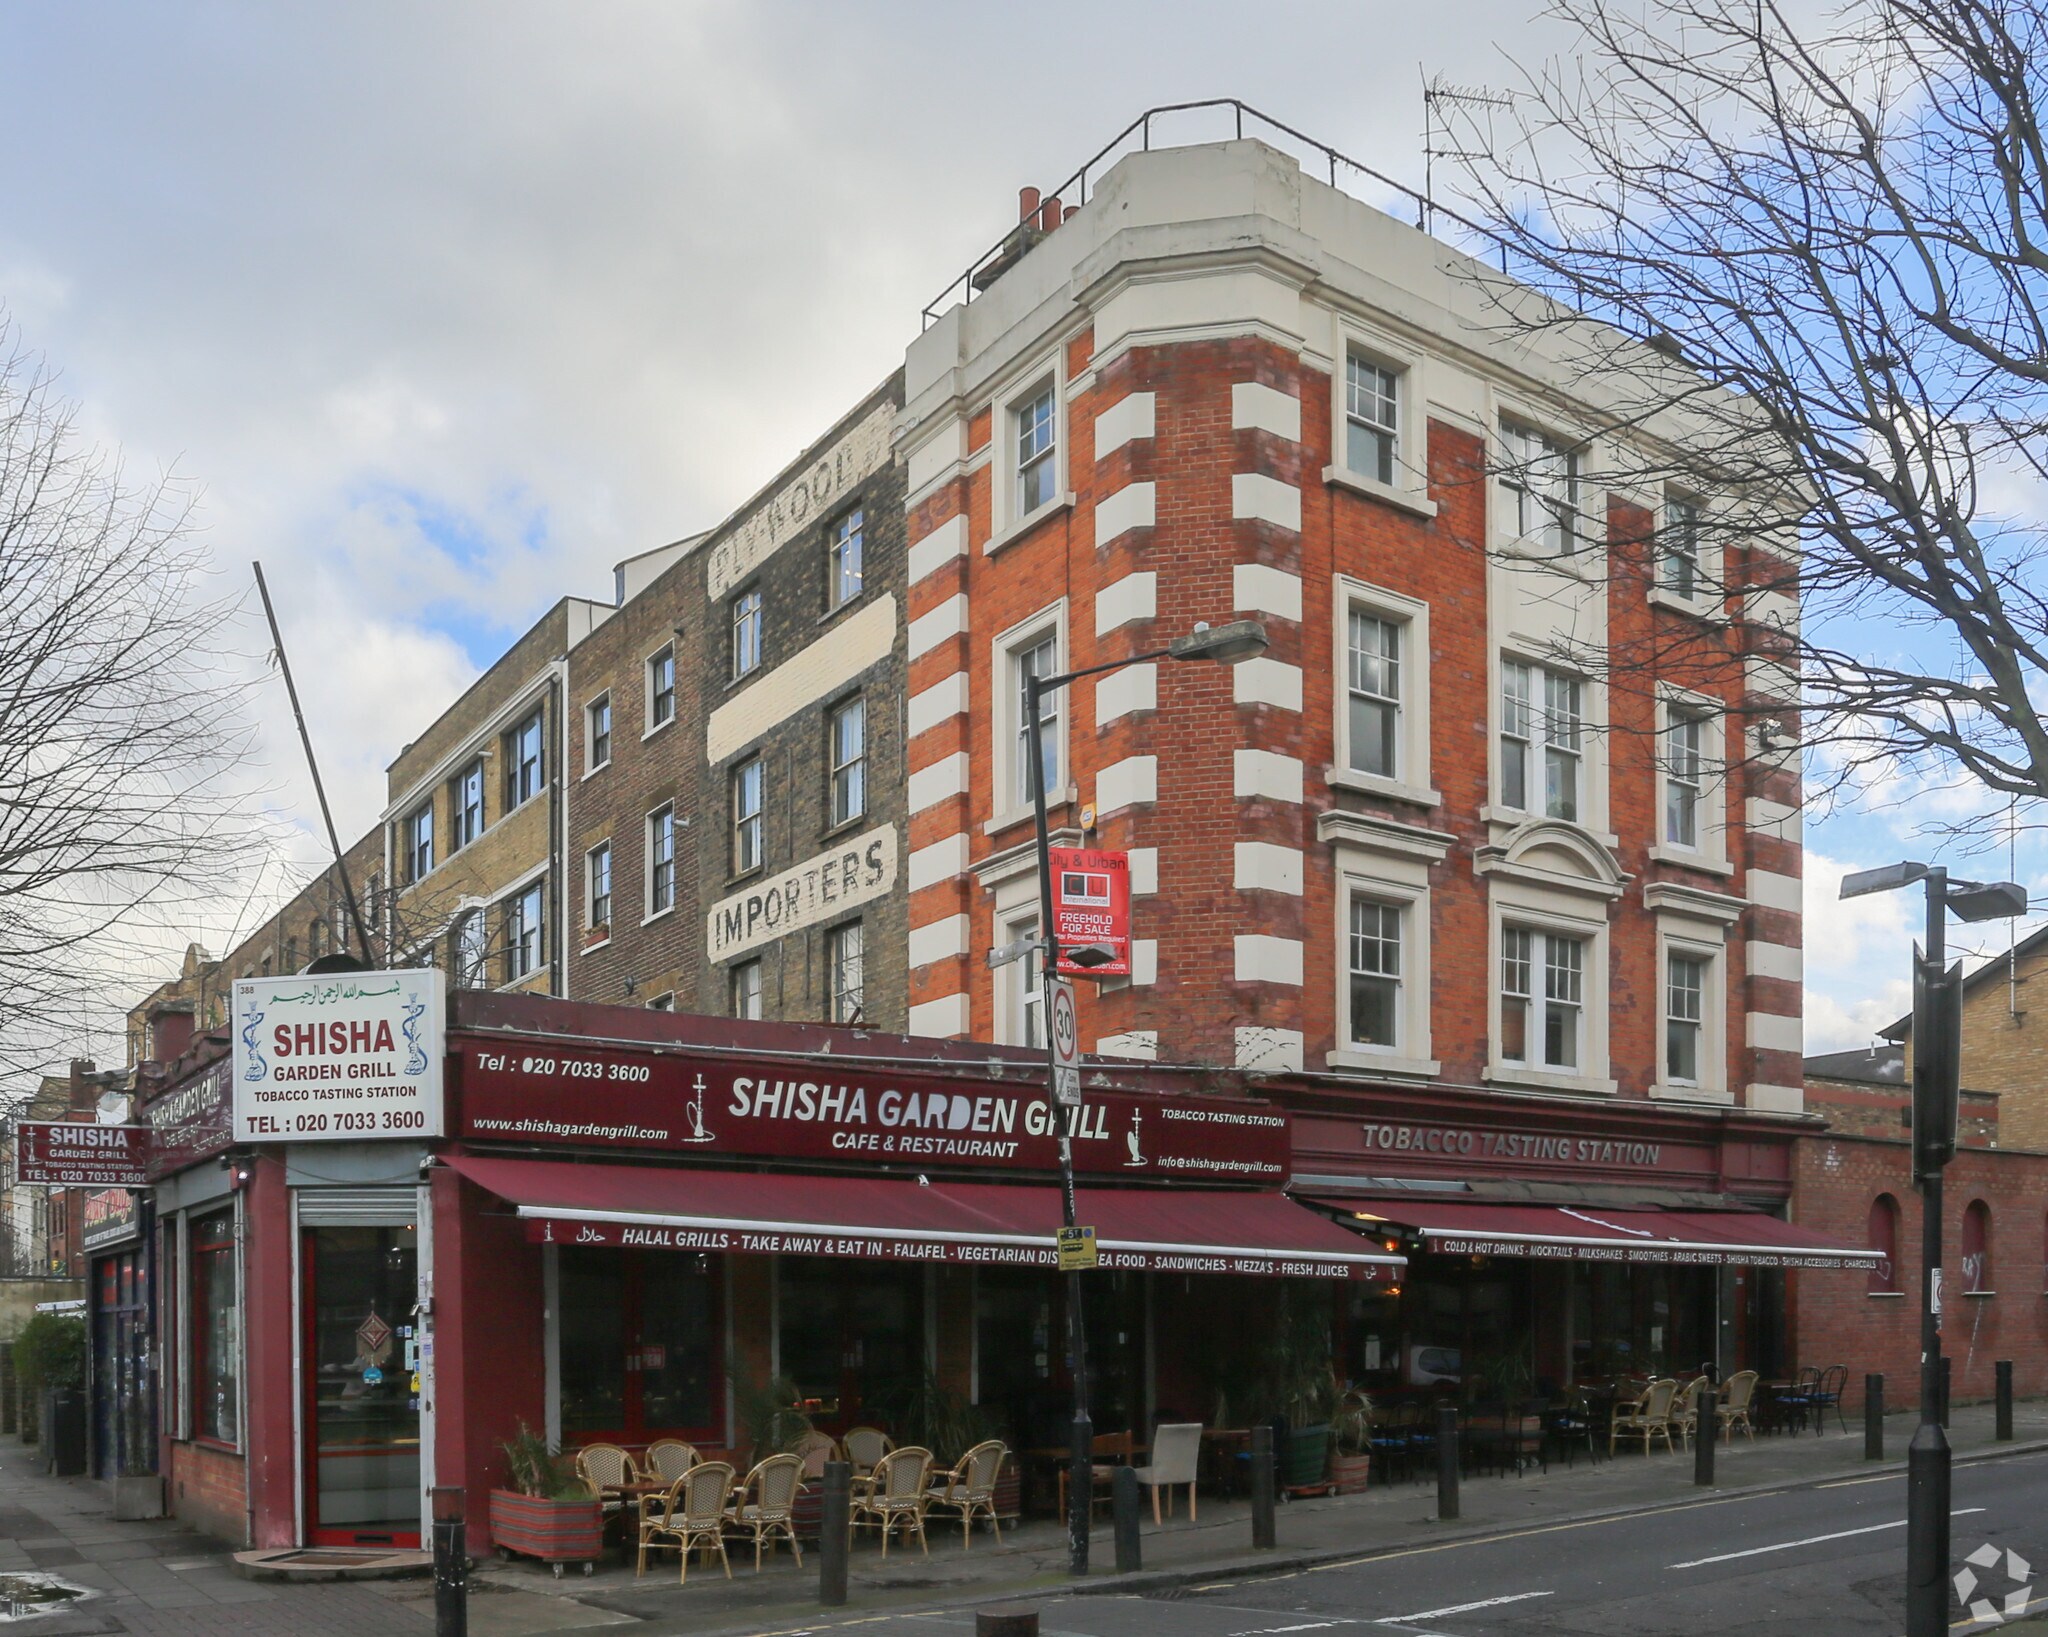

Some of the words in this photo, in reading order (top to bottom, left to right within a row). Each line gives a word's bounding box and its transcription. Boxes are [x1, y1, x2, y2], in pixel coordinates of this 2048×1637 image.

[1073, 854, 1082, 867] &
[1088, 856, 1126, 870] Urban
[716, 840, 884, 951] IMPORTERS
[1060, 912, 1113, 925] FREEHOLD
[1062, 924, 1082, 934] FOR
[1084, 924, 1110, 934] SALE
[240, 986, 254, 994] 388
[1056, 1008, 1072, 1040] 30
[274, 1020, 396, 1057] SHISHA
[274, 1064, 342, 1082] GARDEN
[348, 1062, 396, 1078] GRILL
[477, 1054, 504, 1072] Tel
[522, 1057, 555, 1076] 020
[562, 1060, 603, 1078] 7033
[608, 1064, 650, 1082] 3600
[254, 1090, 309, 1102] TOBACCO
[313, 1088, 363, 1100] TASTING
[366, 1086, 416, 1098] STATION
[728, 1076, 868, 1125] SHISHA
[878, 1089, 1018, 1134] GARDEN
[247, 1116, 280, 1134] TEL
[296, 1114, 327, 1132] 020
[334, 1112, 376, 1130] 7033
[382, 1111, 424, 1130] 3600
[1162, 1109, 1206, 1122] TOBACCO
[1208, 1112, 1246, 1125] TASTING
[1247, 1114, 1285, 1127] STATION
[49, 1128, 128, 1148] SHISHA
[474, 1118, 668, 1141] www.shishagardengrill.com
[50, 1149, 94, 1158] GARDEN
[98, 1150, 128, 1160] GRILL
[832, 1132, 880, 1151] CAFE
[883, 1135, 894, 1152] &
[900, 1136, 1018, 1158] RESTAURANT
[1363, 1124, 1472, 1154] TOBACCO
[1480, 1132, 1570, 1160] TASTING
[1576, 1140, 1660, 1164] STATION
[78, 1162, 106, 1170] TASTING
[1158, 1156, 1282, 1174] info@shishagardengrill.com
[26, 1170, 50, 1180] TEL
[61, 1170, 83, 1181] 020
[88, 1172, 116, 1182] 7033
[622, 1228, 672, 1246] HALAL
[676, 1231, 728, 1248] GRILLS
[742, 1235, 779, 1250] TAKE
[782, 1238, 822, 1252] AWAY
[825, 1240, 834, 1253] &
[838, 1240, 864, 1254] EAT
[867, 1242, 882, 1256] IN
[894, 1244, 946, 1259] FALAFEL
[958, 1246, 1036, 1263] VEGETARIAN
[1444, 1240, 1466, 1252] COLD
[1468, 1242, 1474, 1252] &
[1475, 1242, 1493, 1254] HOT
[1494, 1244, 1524, 1256] DRINKS
[1530, 1246, 1572, 1258] MOCKTAILS
[1578, 1248, 1624, 1260] MILKSHAKES
[1628, 1250, 1668, 1262] SMOOTHIES
[1674, 1252, 1697, 1262] ARABIC
[1698, 1254, 1722, 1264] SWEETS
[1726, 1254, 1750, 1264] SHISHA
[1750, 1256, 1778, 1266] TOBACCO
[1782, 1256, 1802, 1266] SHISHA
[1804, 1258, 1840, 1268] ACCESSORIES
[1844, 1258, 1876, 1269] CHARCOALS
[1097, 1254, 1113, 1266] EA
[1116, 1254, 1146, 1268] FOOD
[1155, 1256, 1226, 1272] SANDWICHES
[1235, 1260, 1273, 1274] MEZZA'S
[1282, 1262, 1314, 1276] FRESH
[1316, 1264, 1349, 1277] JUICES
